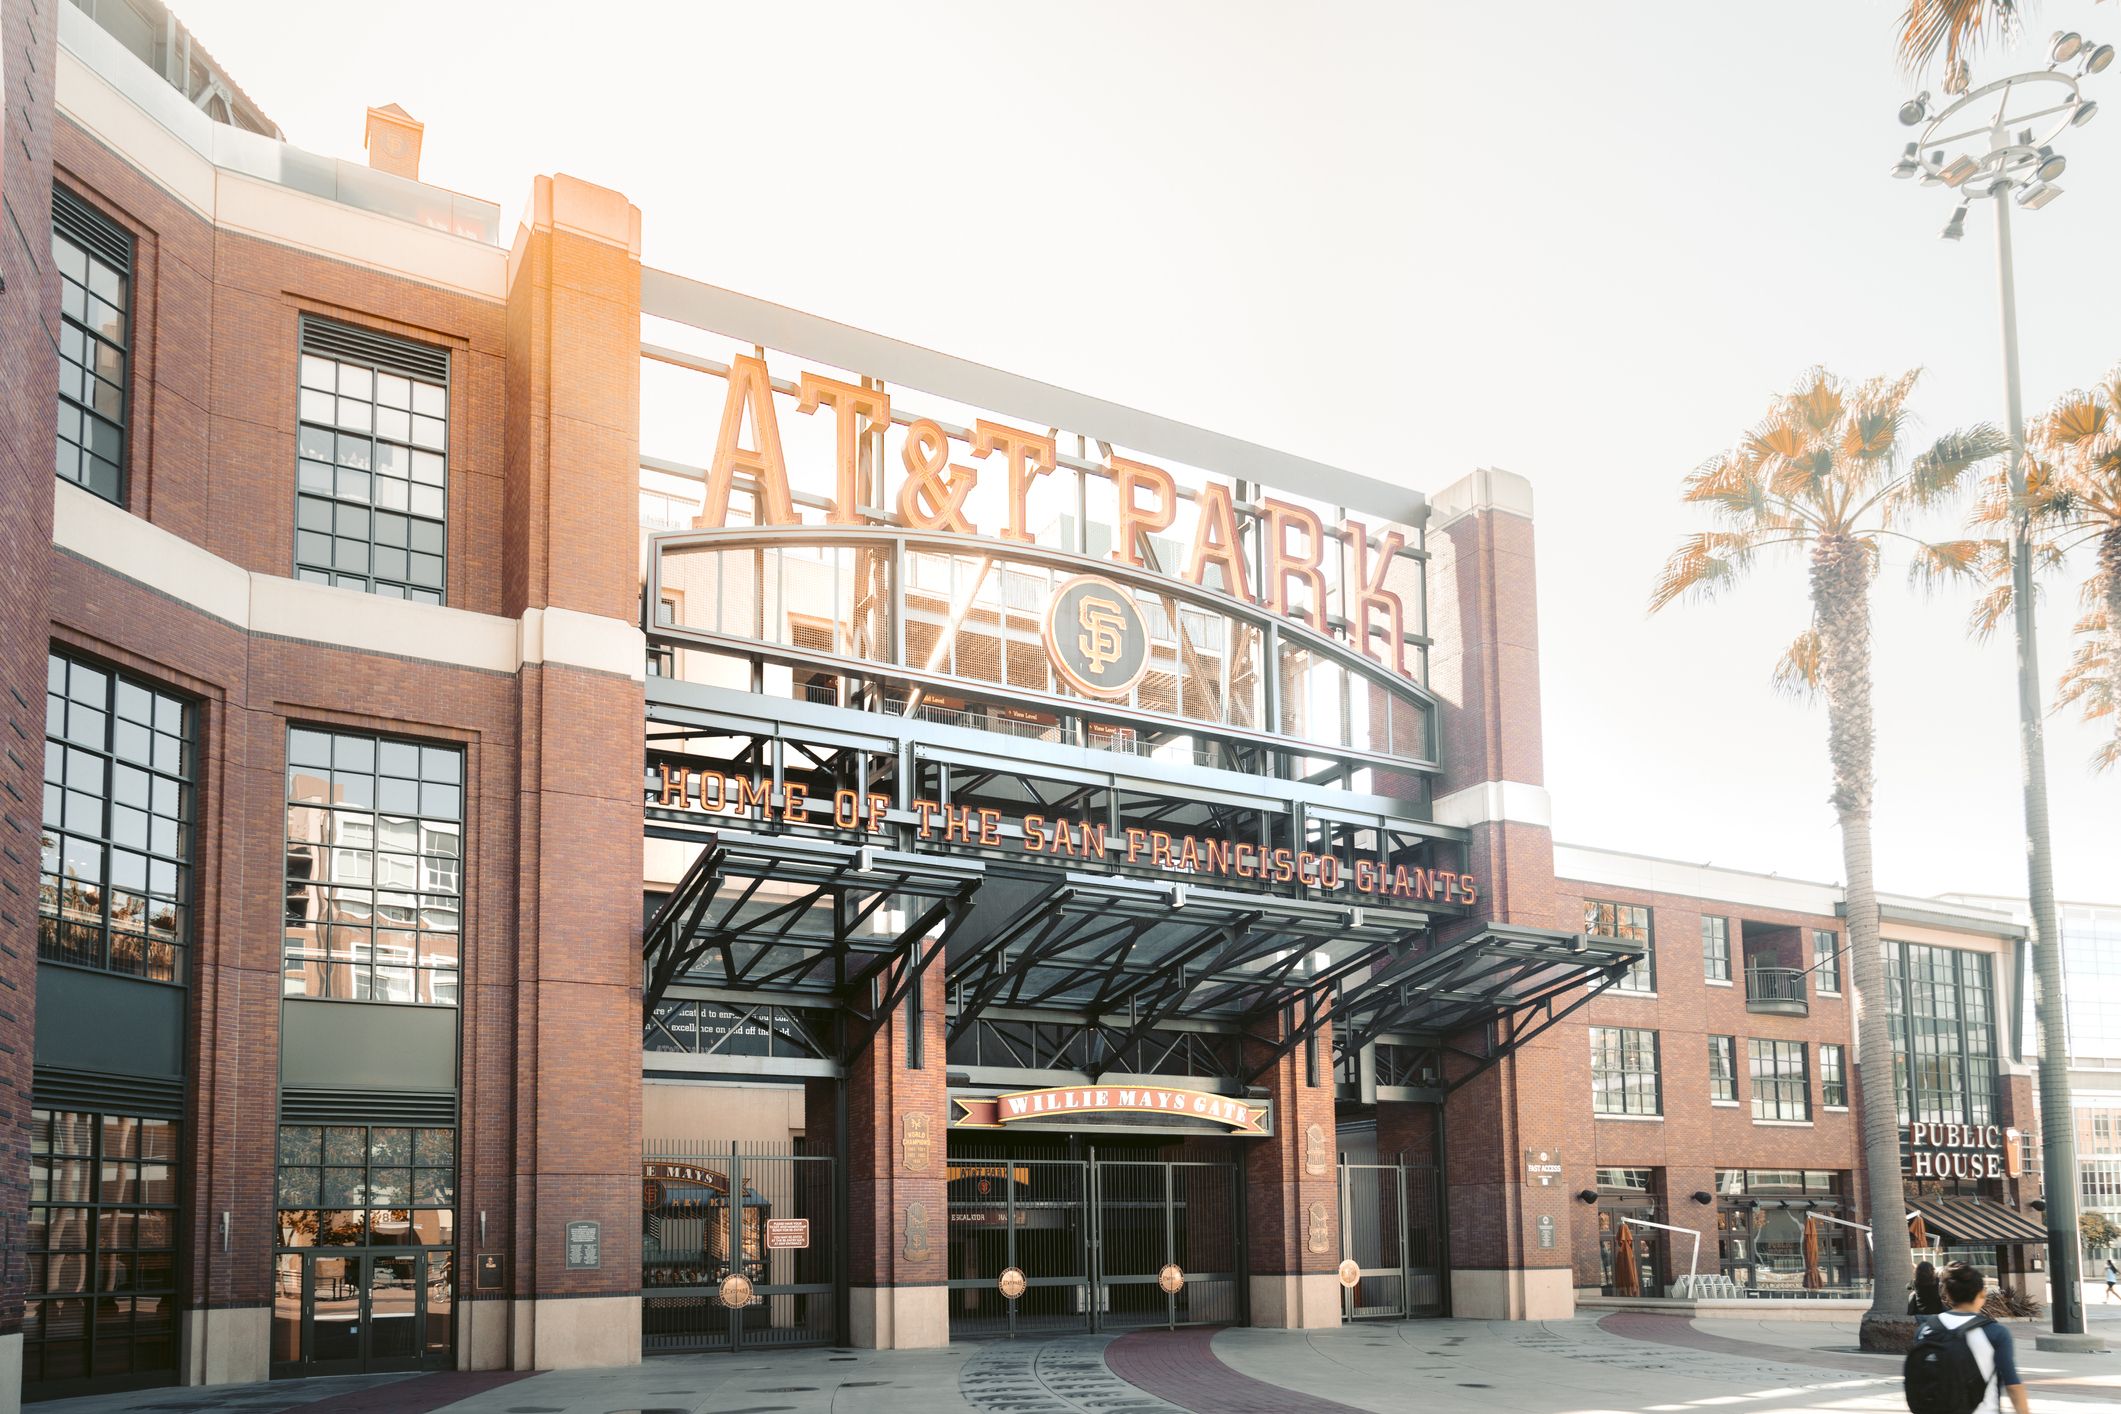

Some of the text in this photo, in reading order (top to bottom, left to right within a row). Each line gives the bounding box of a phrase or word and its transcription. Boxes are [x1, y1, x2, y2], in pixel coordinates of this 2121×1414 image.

[692, 353, 1414, 679] AT&T PARK
[1077, 594, 1128, 675] SF
[658, 763, 1480, 906] HOME OF THE SAN FRANCISCO GIANTS
[708, 1010, 717, 1018] to
[745, 1026, 757, 1035] off
[1008, 1090, 1249, 1124] WILLIE MAYS GATE
[1912, 1122, 1999, 1149] PUBLIC
[666, 1166, 714, 1183] MAYS
[1528, 1164, 1562, 1173] FAST ACCESS
[1914, 1152, 2002, 1179] HOUSE
[951, 1213, 985, 1221] ESCALATOR
